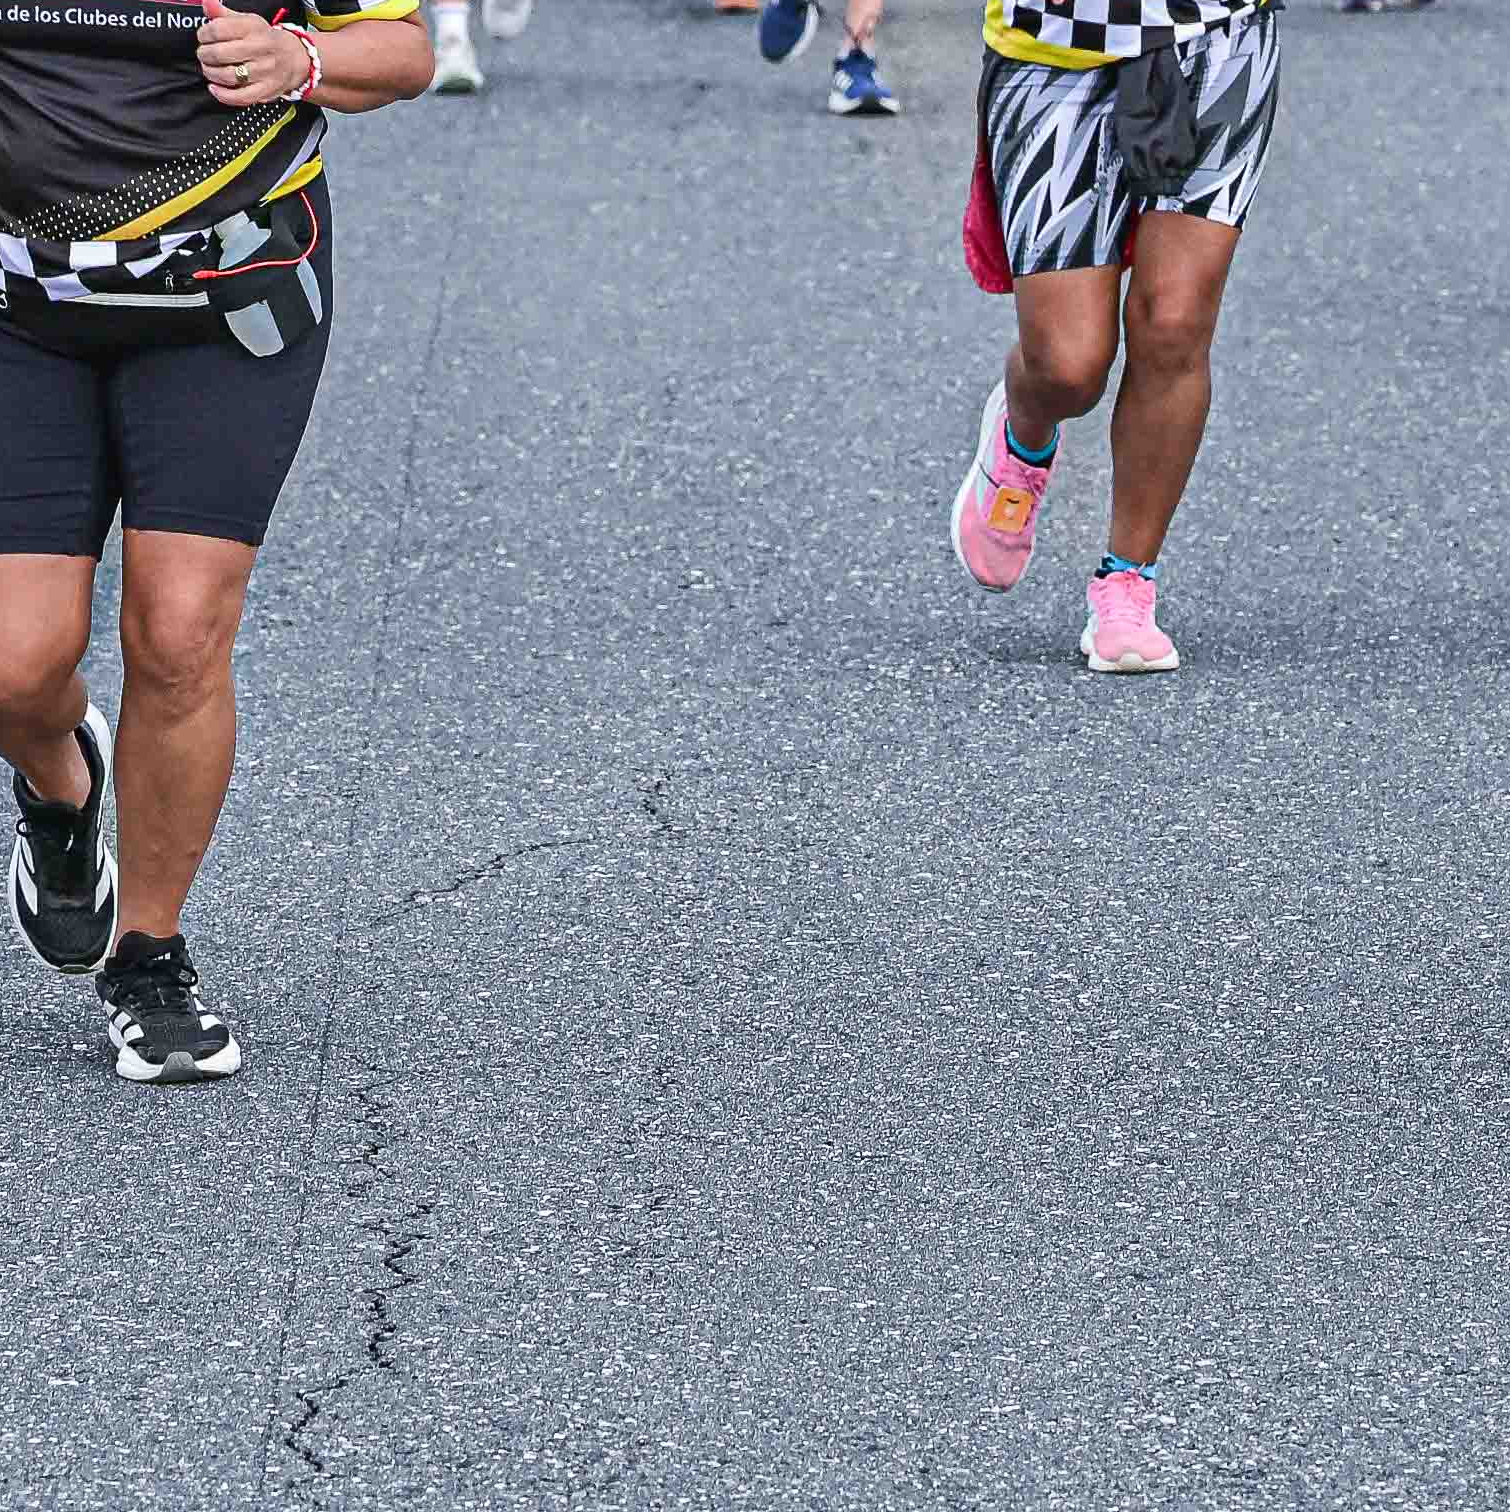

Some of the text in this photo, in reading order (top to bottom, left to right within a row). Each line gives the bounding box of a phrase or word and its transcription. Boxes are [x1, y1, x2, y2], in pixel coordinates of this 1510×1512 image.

[7, 4, 29, 24] de
[34, 5, 60, 25] los
[64, 7, 128, 29] Clubes
[132, 10, 162, 29] del
